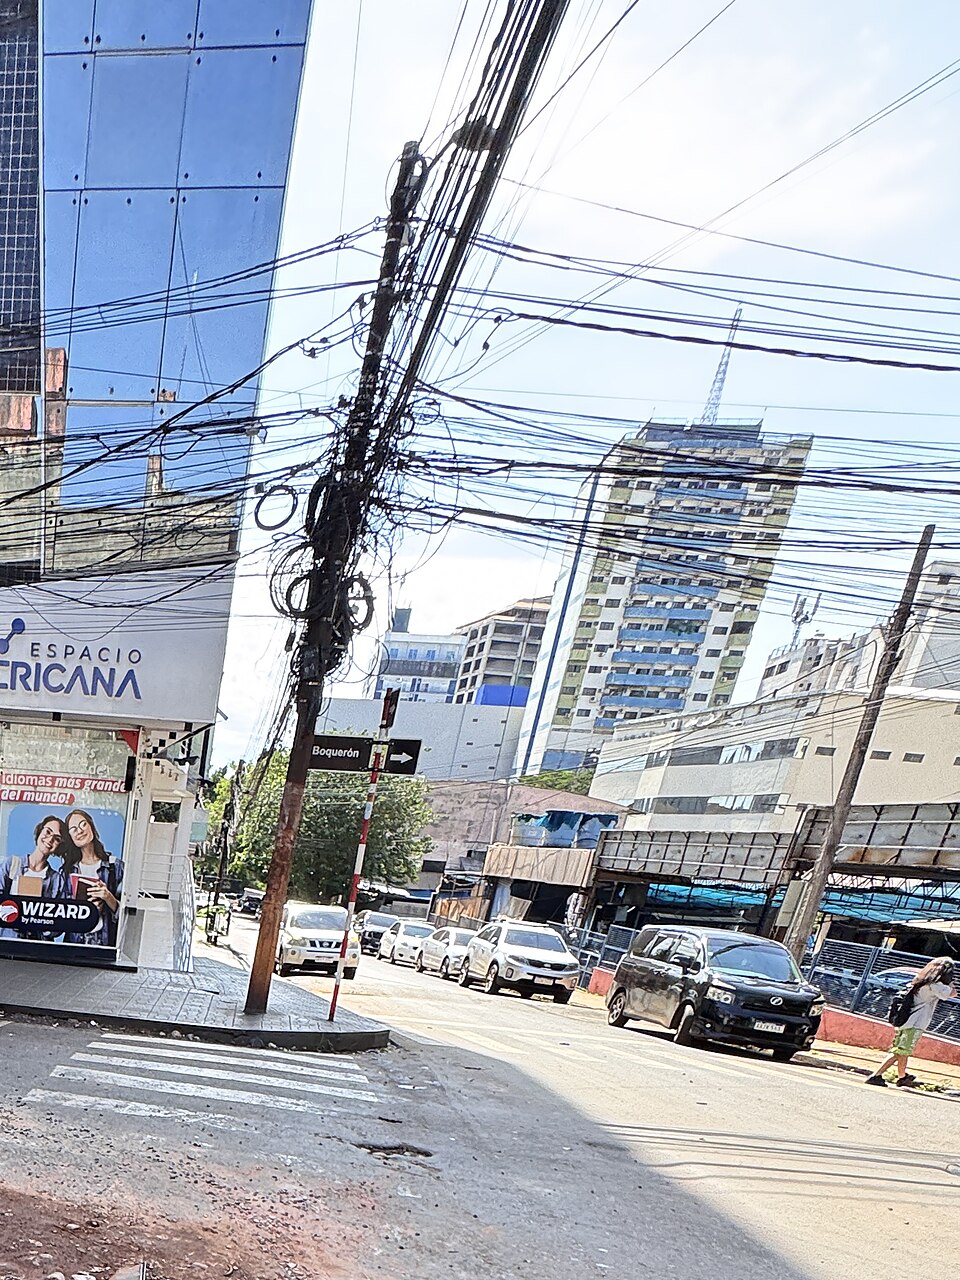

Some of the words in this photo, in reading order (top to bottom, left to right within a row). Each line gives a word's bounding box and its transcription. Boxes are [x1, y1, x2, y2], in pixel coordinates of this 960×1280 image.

[30, 642, 142, 665] ESPACIO
[312, 745, 360, 759] Boquerón
[54, 776, 82, 789] más
[83, 778, 127, 793] grande
[1, 788, 21, 801] del
[23, 791, 71, 804] mundo!
[22, 900, 91, 920] WIZARD
[21, 916, 30, 925] by
[30, 917, 54, 926] Pearson
